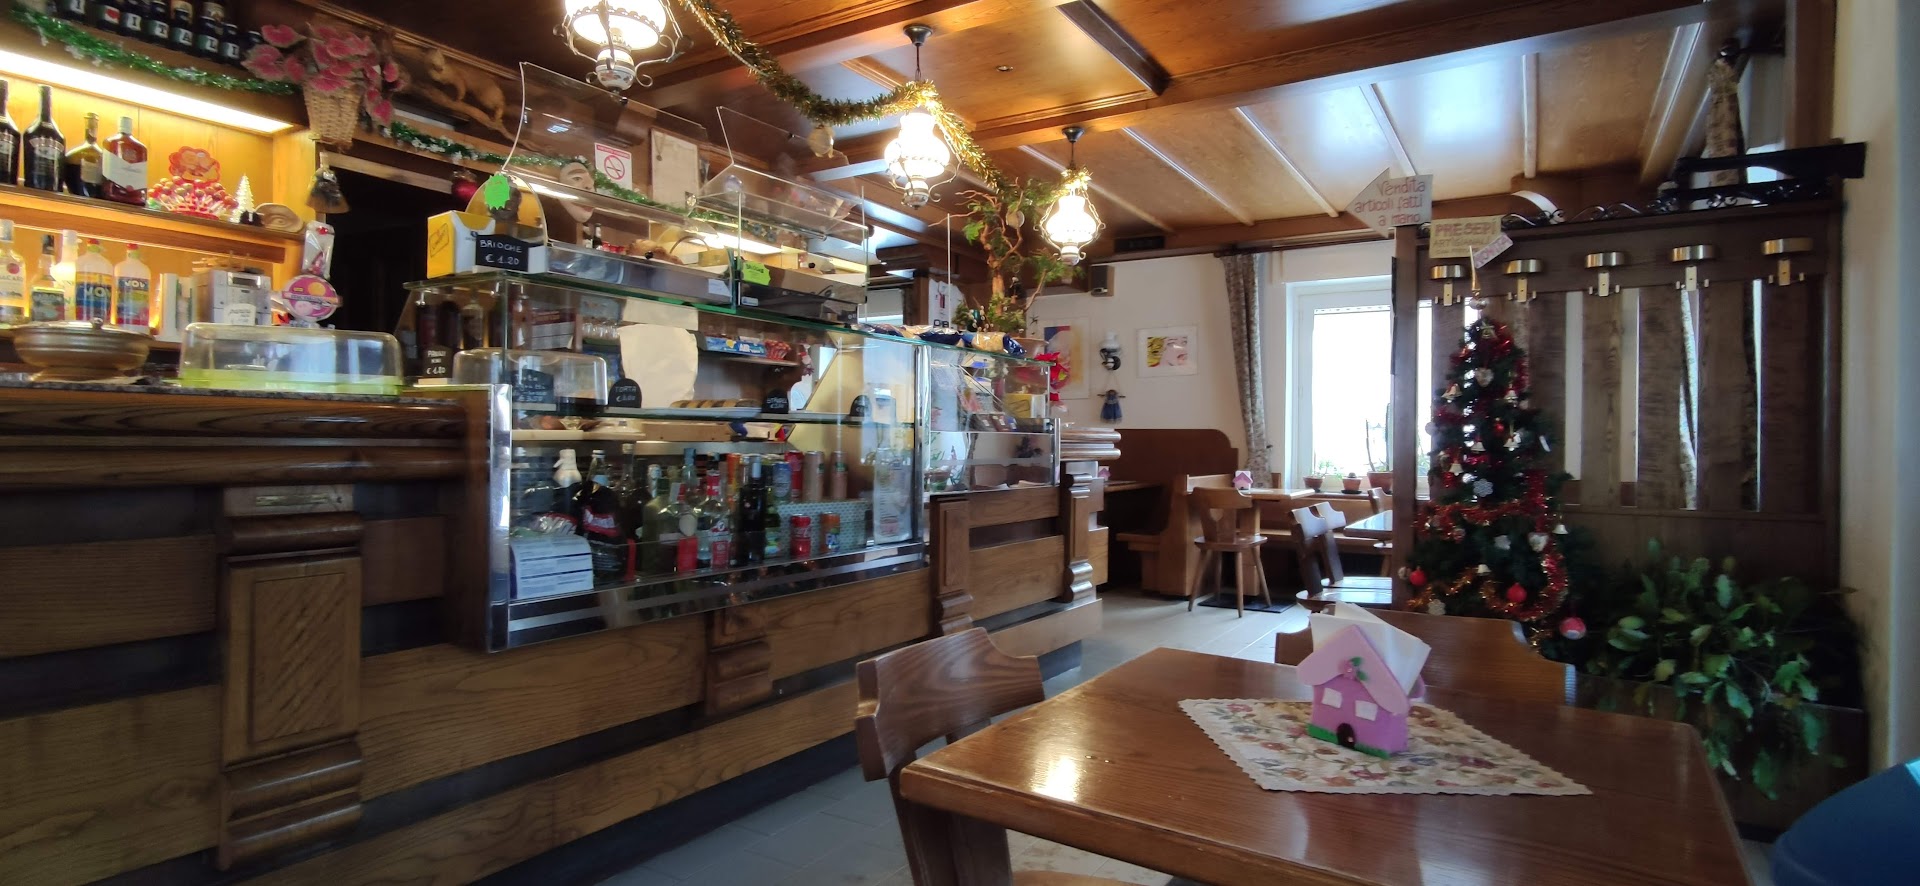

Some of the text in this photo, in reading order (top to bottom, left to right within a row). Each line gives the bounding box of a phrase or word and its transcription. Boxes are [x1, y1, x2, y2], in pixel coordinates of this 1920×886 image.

[1376, 176, 1426, 197] Vendita
[1354, 195, 1423, 214] articoli fatti
[1378, 212, 1422, 227] a mano
[479, 240, 523, 254] BRIOCHE
[485, 253, 520, 266] € 1.20
[124, 279, 147, 289] VOV
